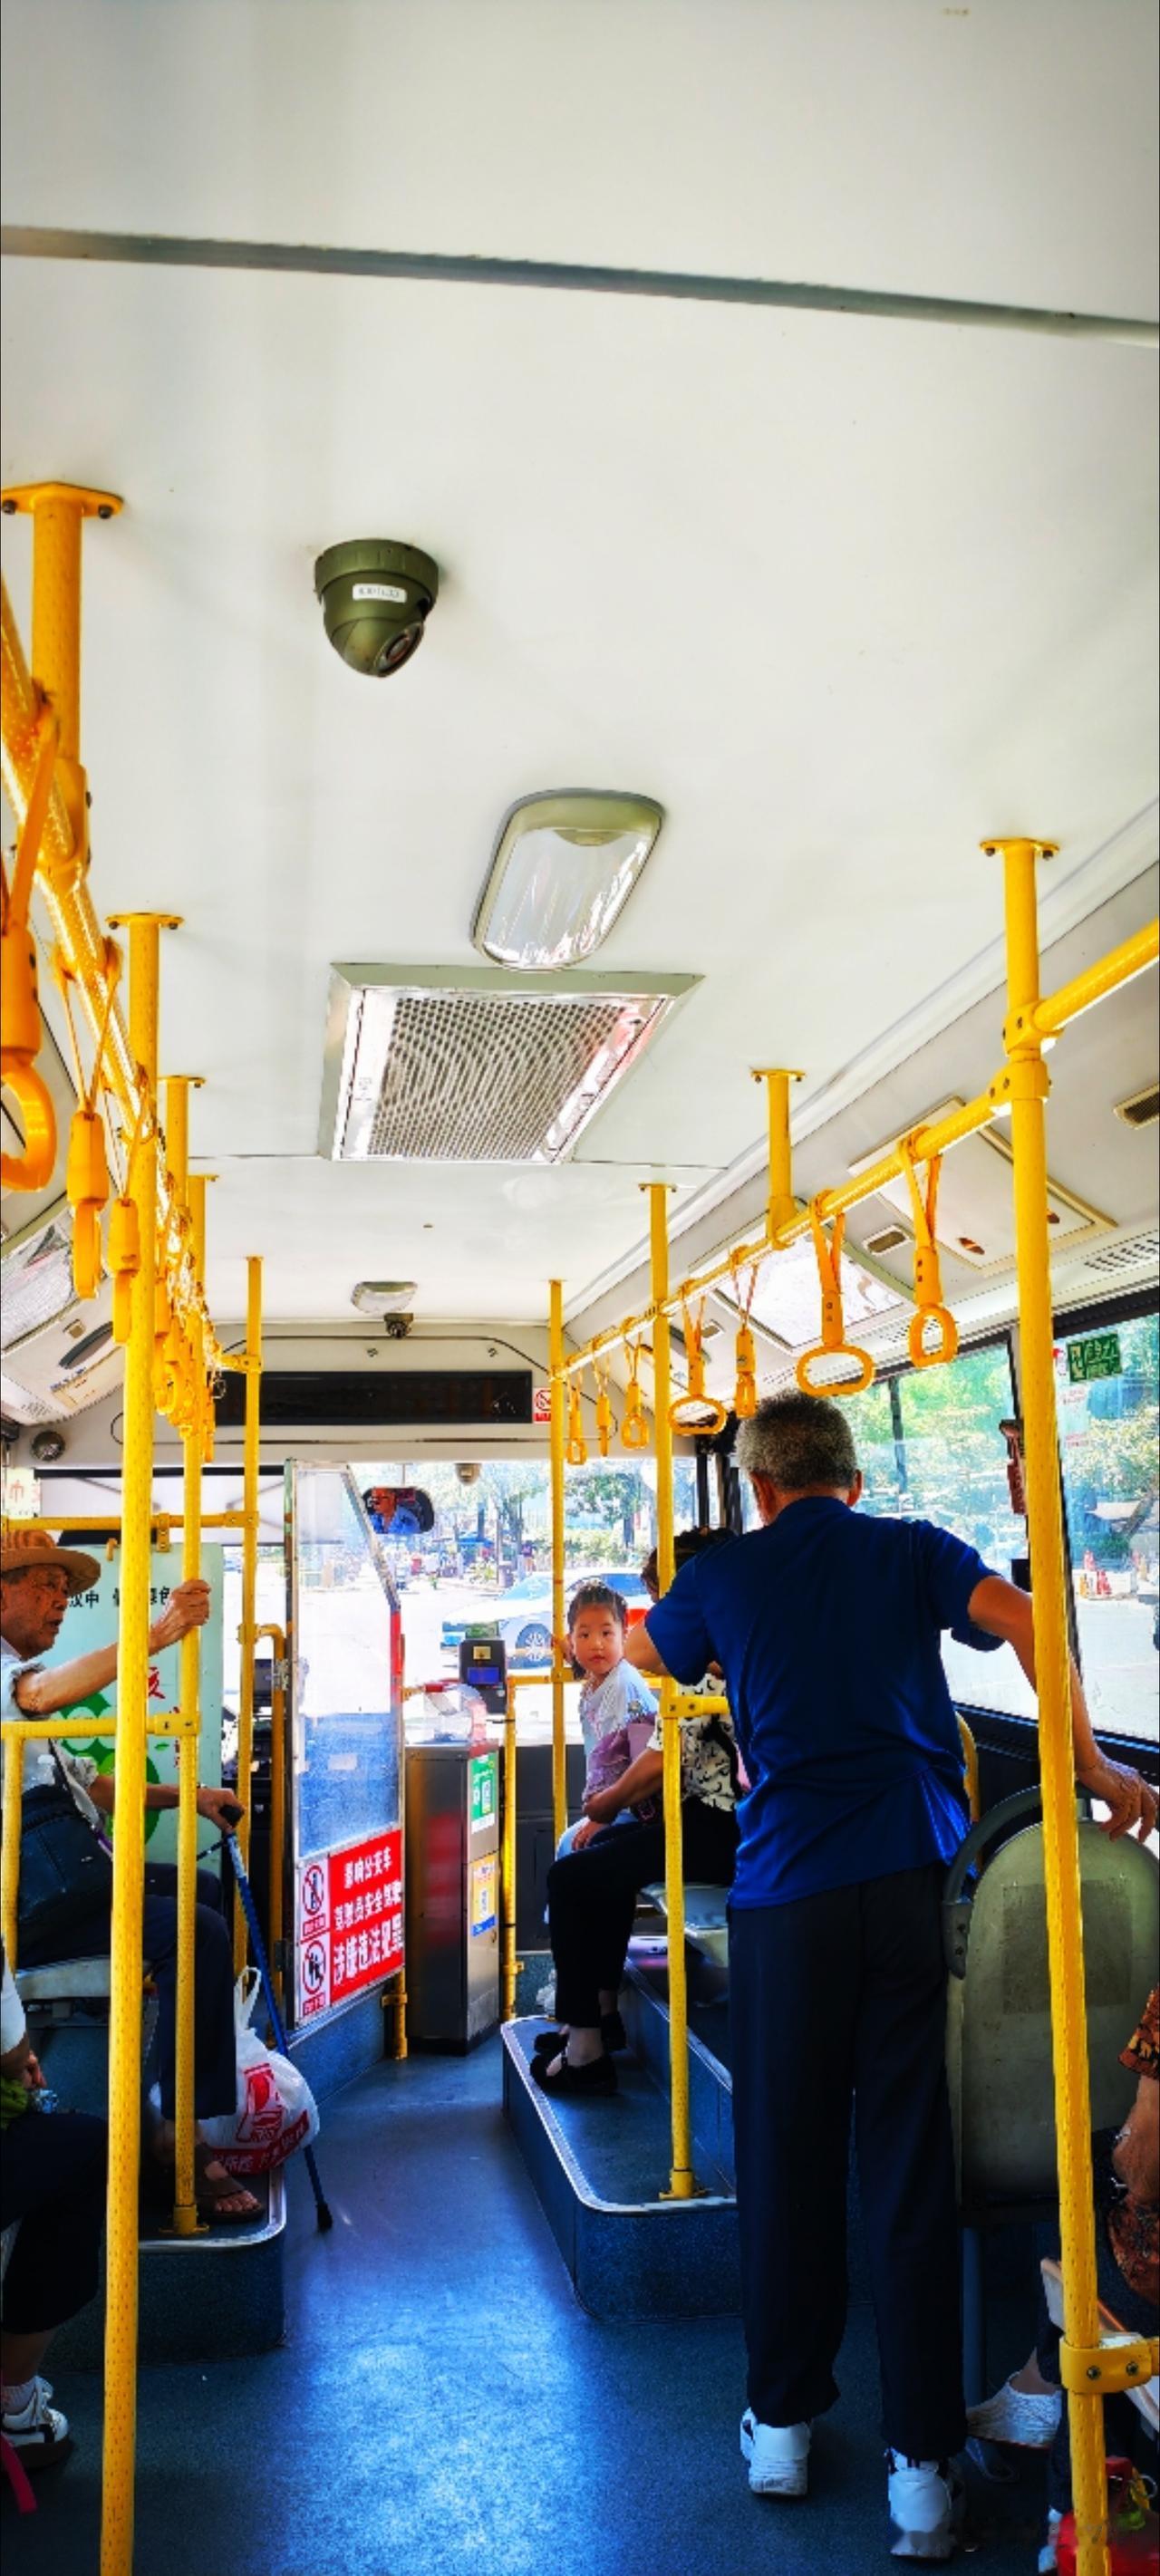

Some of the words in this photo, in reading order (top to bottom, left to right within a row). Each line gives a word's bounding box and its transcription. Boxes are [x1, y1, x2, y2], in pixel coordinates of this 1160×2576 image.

[344, 1847, 392, 1889] 影响公交车
[334, 1913, 403, 1985] 涉嫌违法犯罪
